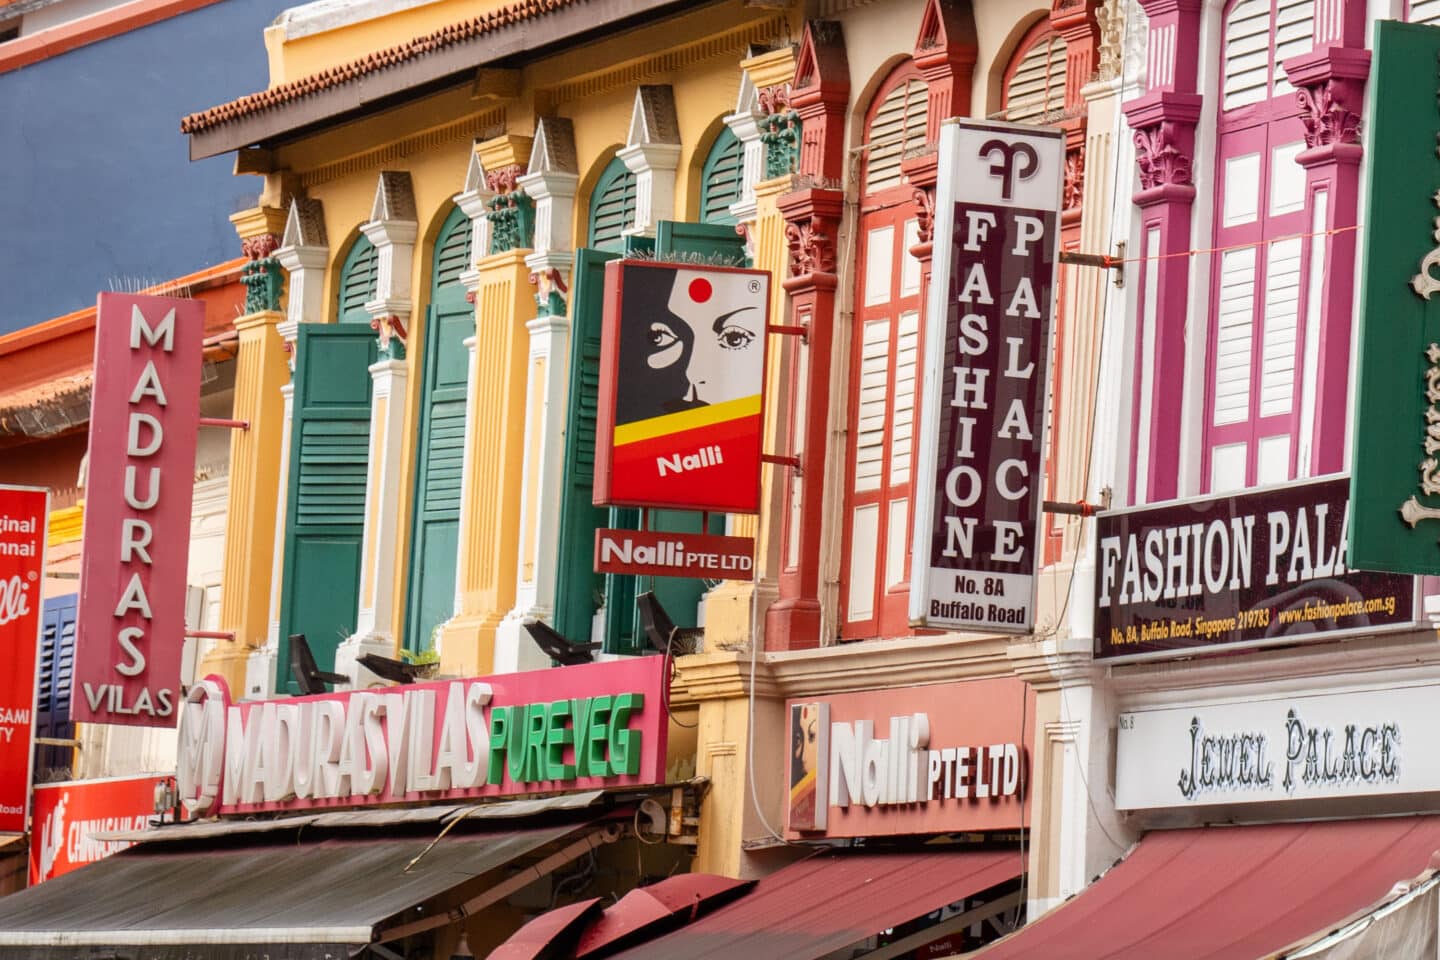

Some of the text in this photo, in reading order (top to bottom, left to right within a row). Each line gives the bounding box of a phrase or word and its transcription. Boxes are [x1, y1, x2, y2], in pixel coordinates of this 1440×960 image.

[942, 208, 997, 560] FASHION
[990, 214, 1044, 564] PALACE
[115, 303, 175, 678] MADURAS
[657, 445, 724, 477] Nalli
[601, 537, 752, 571] Nalli PTE LTD
[955, 575, 1004, 596] No. 8A
[1099, 514, 1255, 609] FASHION
[930, 599, 1026, 624] Buffalo Road
[1111, 628, 1125, 645] No.
[1141, 621, 1169, 641] Buffalo
[1195, 615, 1236, 639] Singapore
[1237, 608, 1269, 630] 219783
[1278, 595, 1396, 624] www.fashionpalace.com.sg
[83, 681, 173, 718] VILAS
[829, 712, 1019, 808] Nalli PTE LTD
[1177, 706, 1400, 799] JEWEL PALACE
